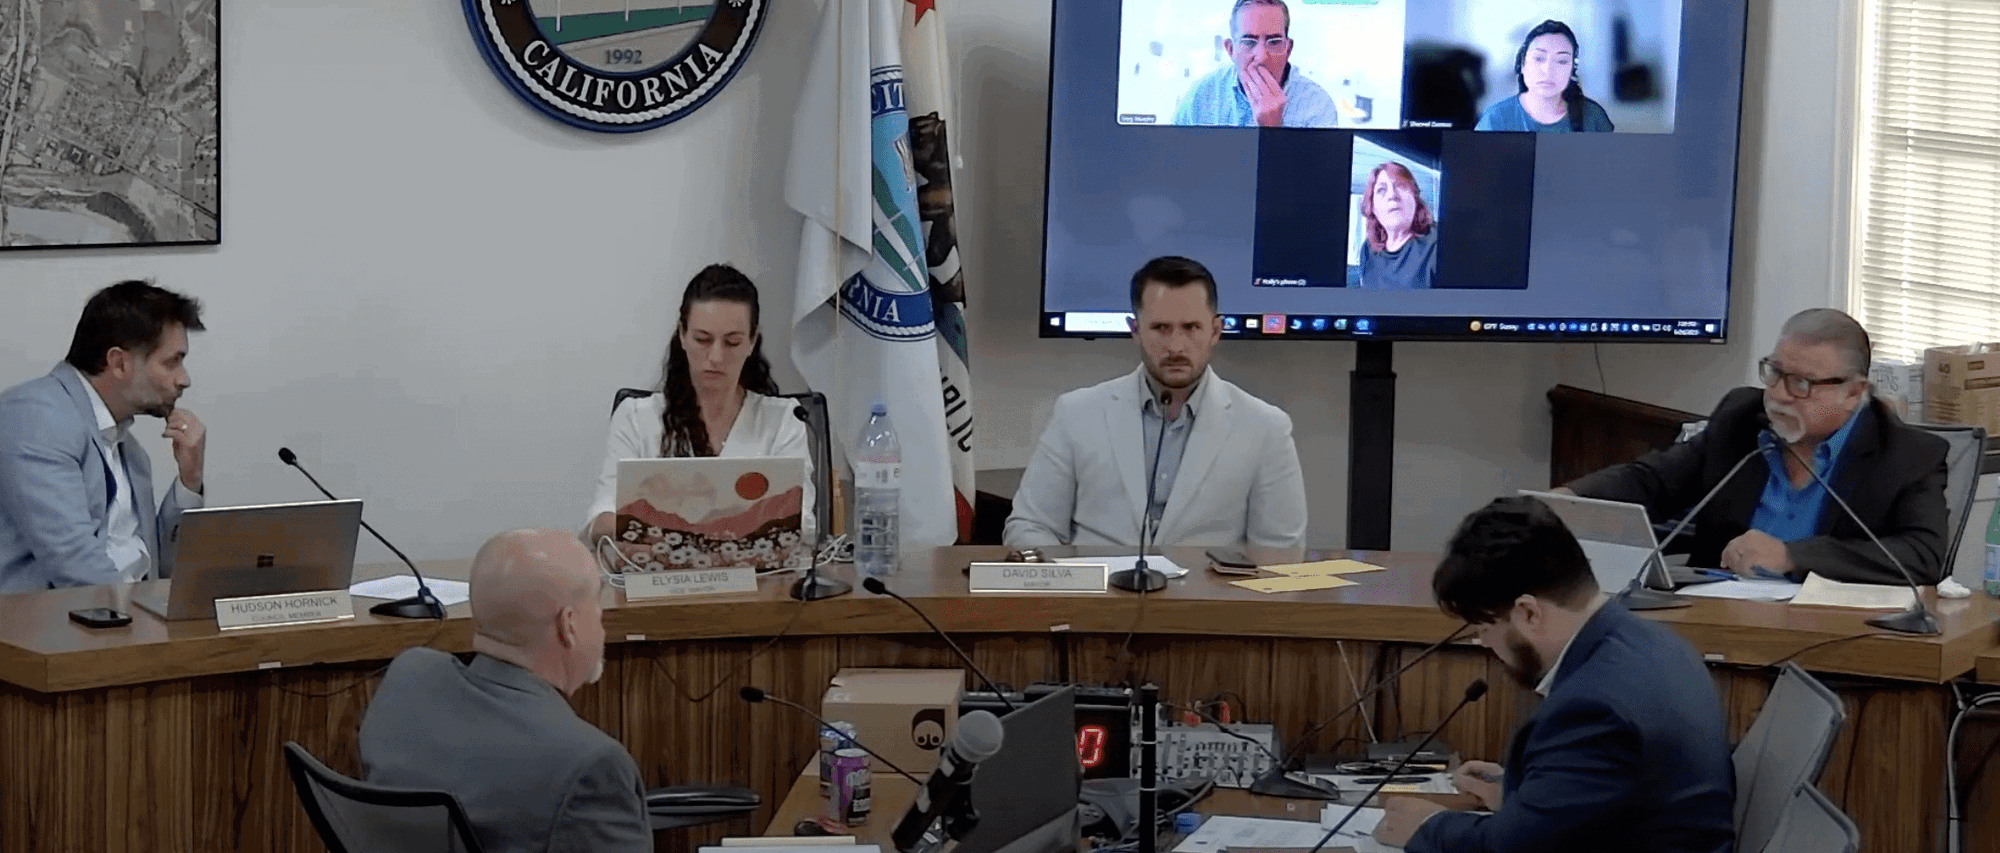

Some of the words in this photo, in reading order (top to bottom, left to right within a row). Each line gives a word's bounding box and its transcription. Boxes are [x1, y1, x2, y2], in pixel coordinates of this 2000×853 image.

[604, 49, 643, 65] 1992
[523, 39, 725, 109] CALIFORNIA
[652, 574, 691, 586] ELYSIA
[693, 572, 729, 583] LEWIS
[1002, 568, 1038, 578] DAVID
[1041, 568, 1073, 578] SILVA
[230, 600, 282, 613] HUDSON
[285, 596, 337, 608] HORNICK
